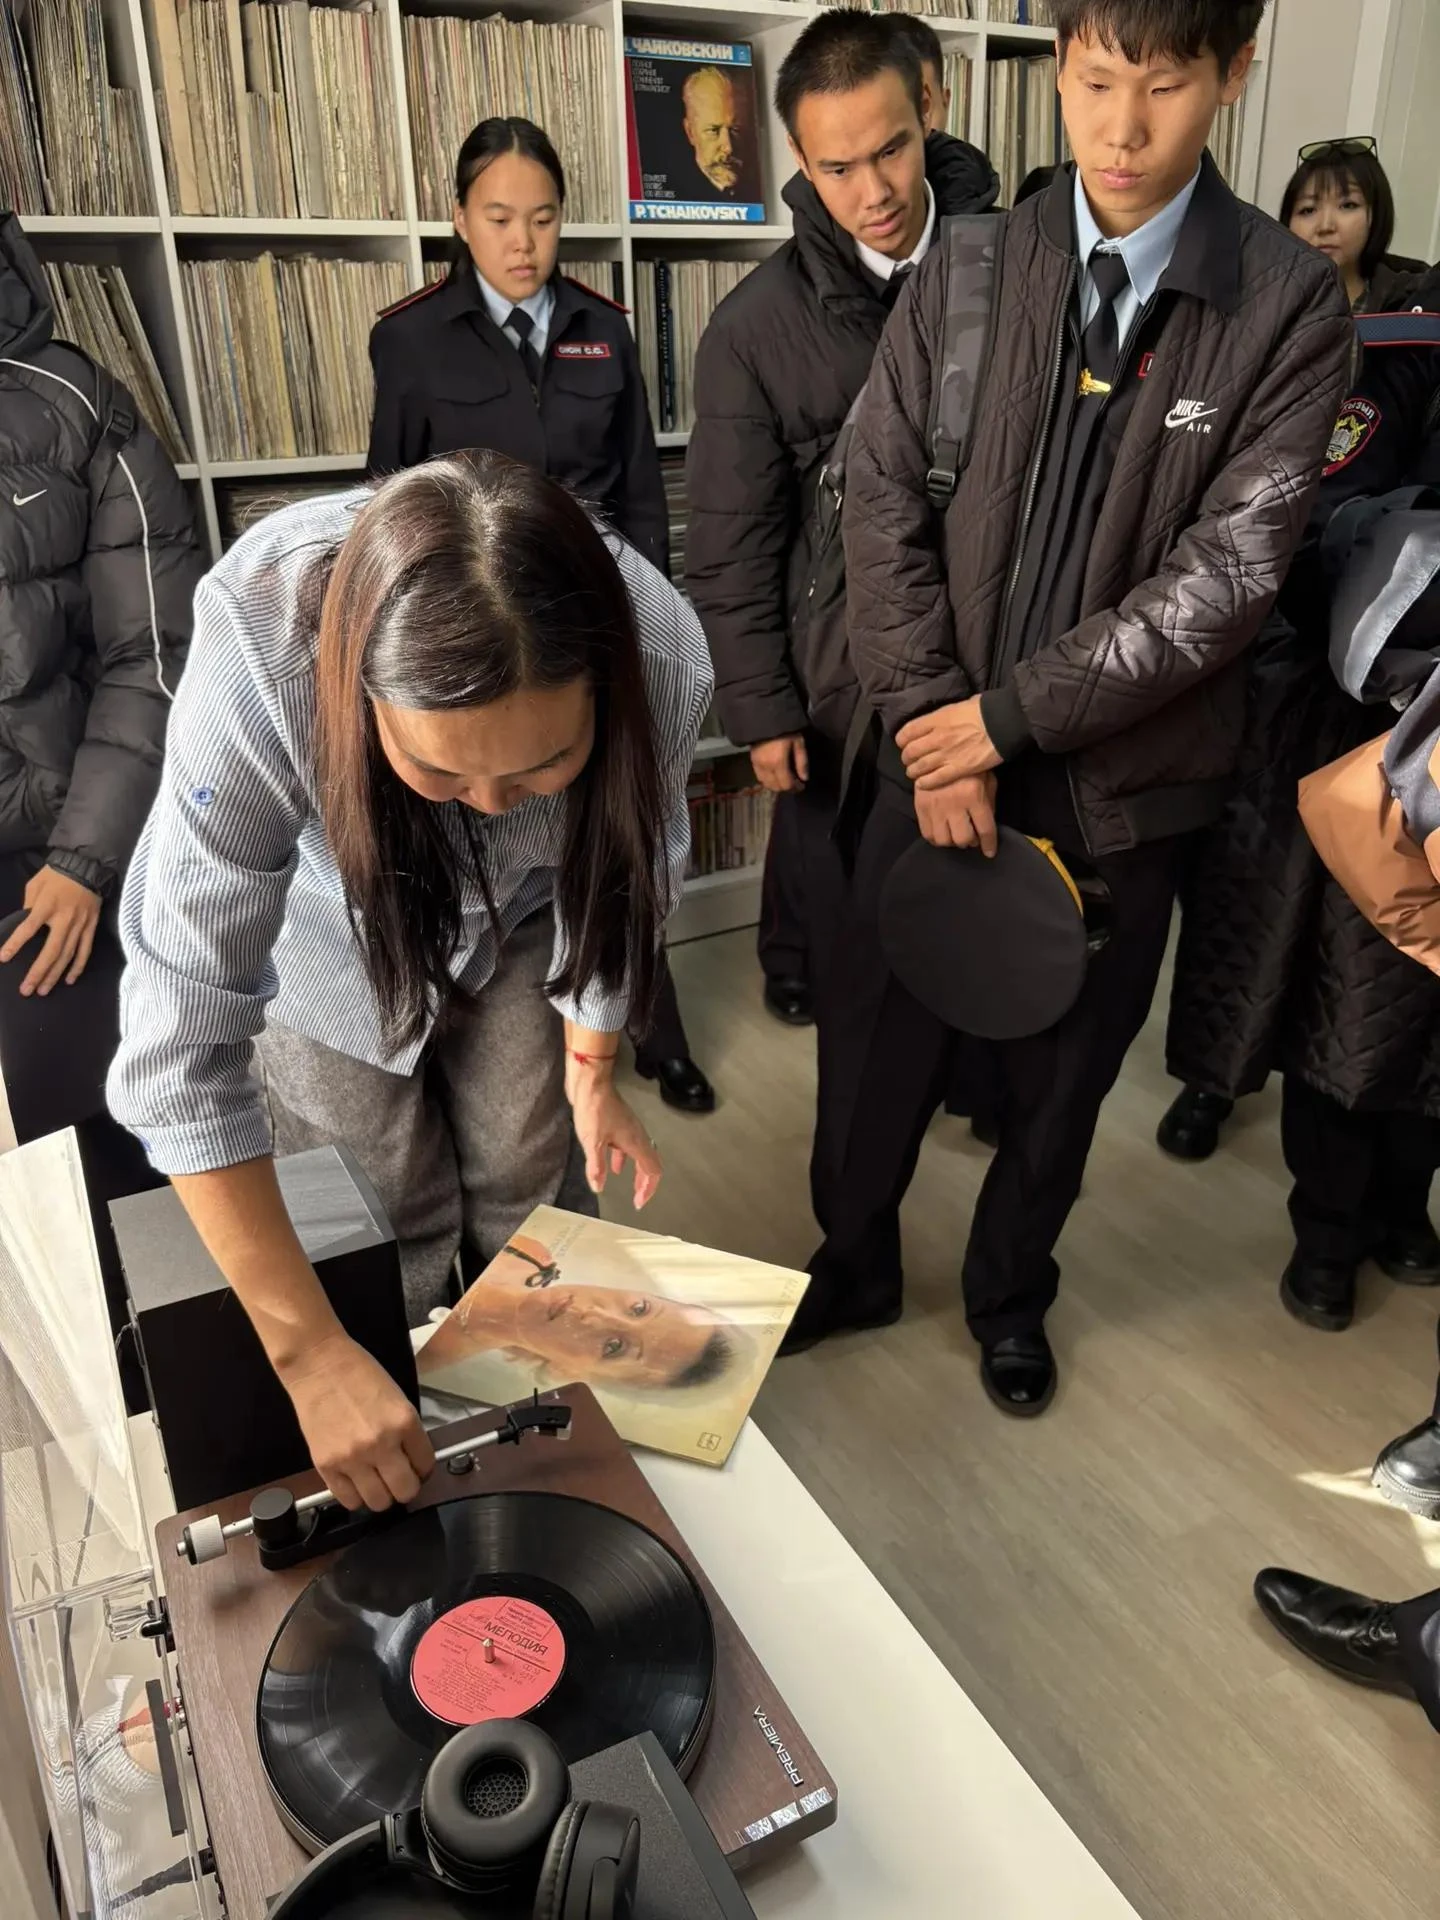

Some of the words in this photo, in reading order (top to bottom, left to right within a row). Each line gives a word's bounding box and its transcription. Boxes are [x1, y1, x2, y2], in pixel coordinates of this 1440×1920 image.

[634, 204, 749, 220] P.TCHAIKOVSKY
[1172, 398, 1205, 417] NIKE
[1186, 421, 1212, 434] AIR
[484, 1621, 548, 1656] МЕЛОДИЯ
[753, 1704, 804, 1786] PREMIERA
